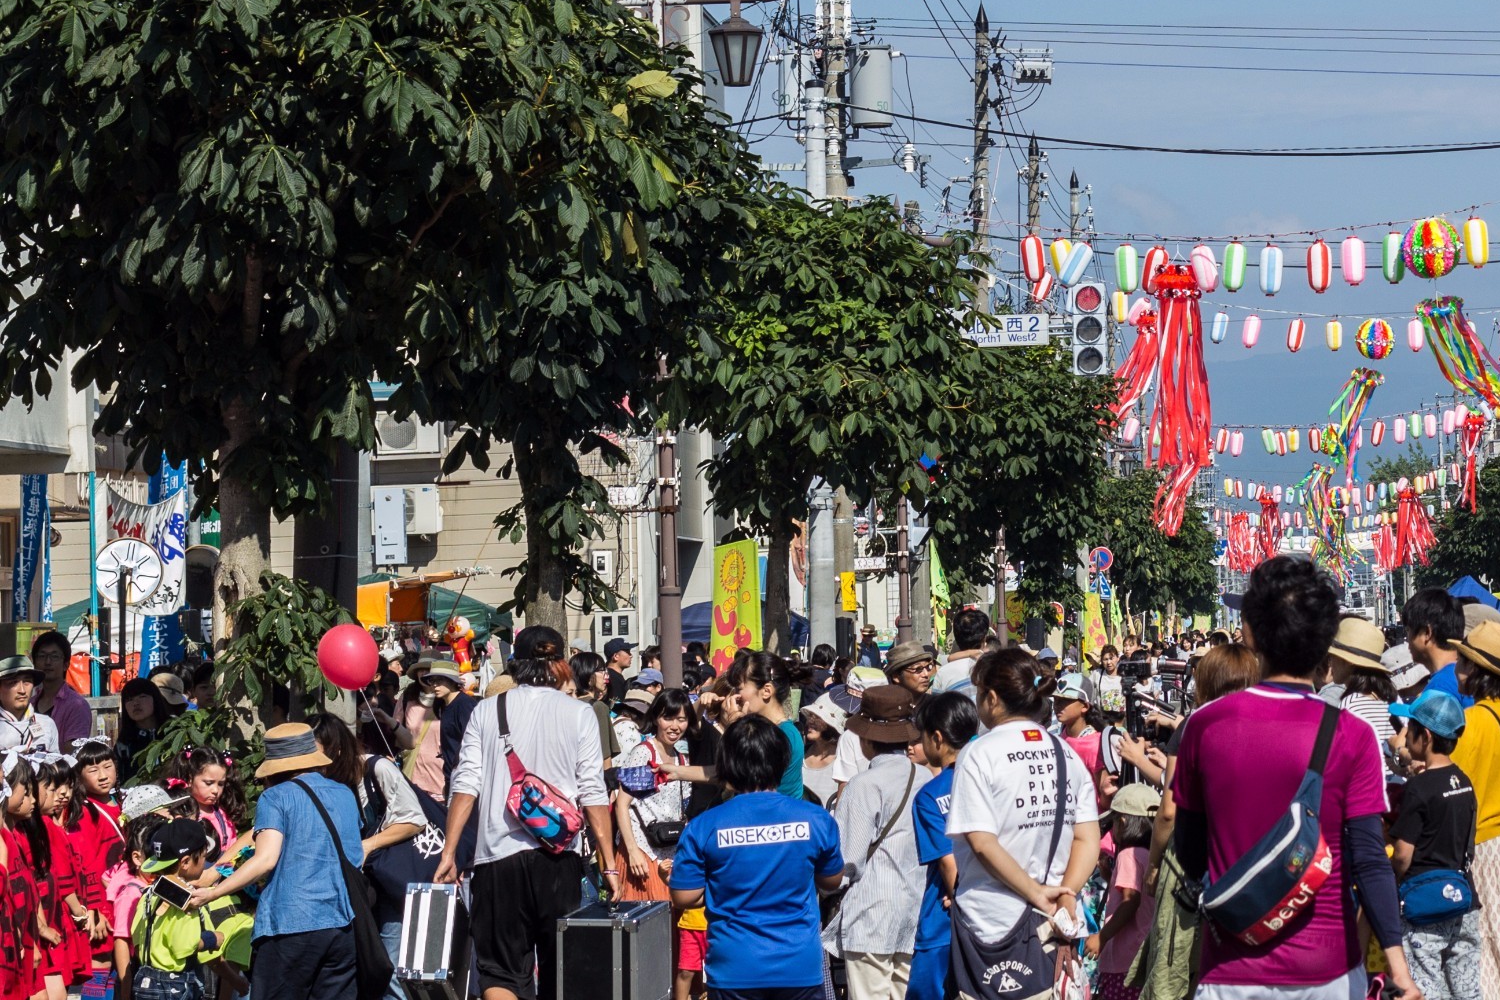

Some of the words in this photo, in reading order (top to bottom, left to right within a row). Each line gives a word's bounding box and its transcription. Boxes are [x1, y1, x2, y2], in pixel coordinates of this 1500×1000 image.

[876, 101, 889, 112] 50
[1006, 317, 1022, 333] 西
[1028, 316, 1039, 332] 2
[1007, 333, 1037, 342] West2
[1007, 748, 1074, 763] ROCK'N'RLL
[783, 823, 809, 839] F.C.
[1263, 882, 1314, 931] beruf
